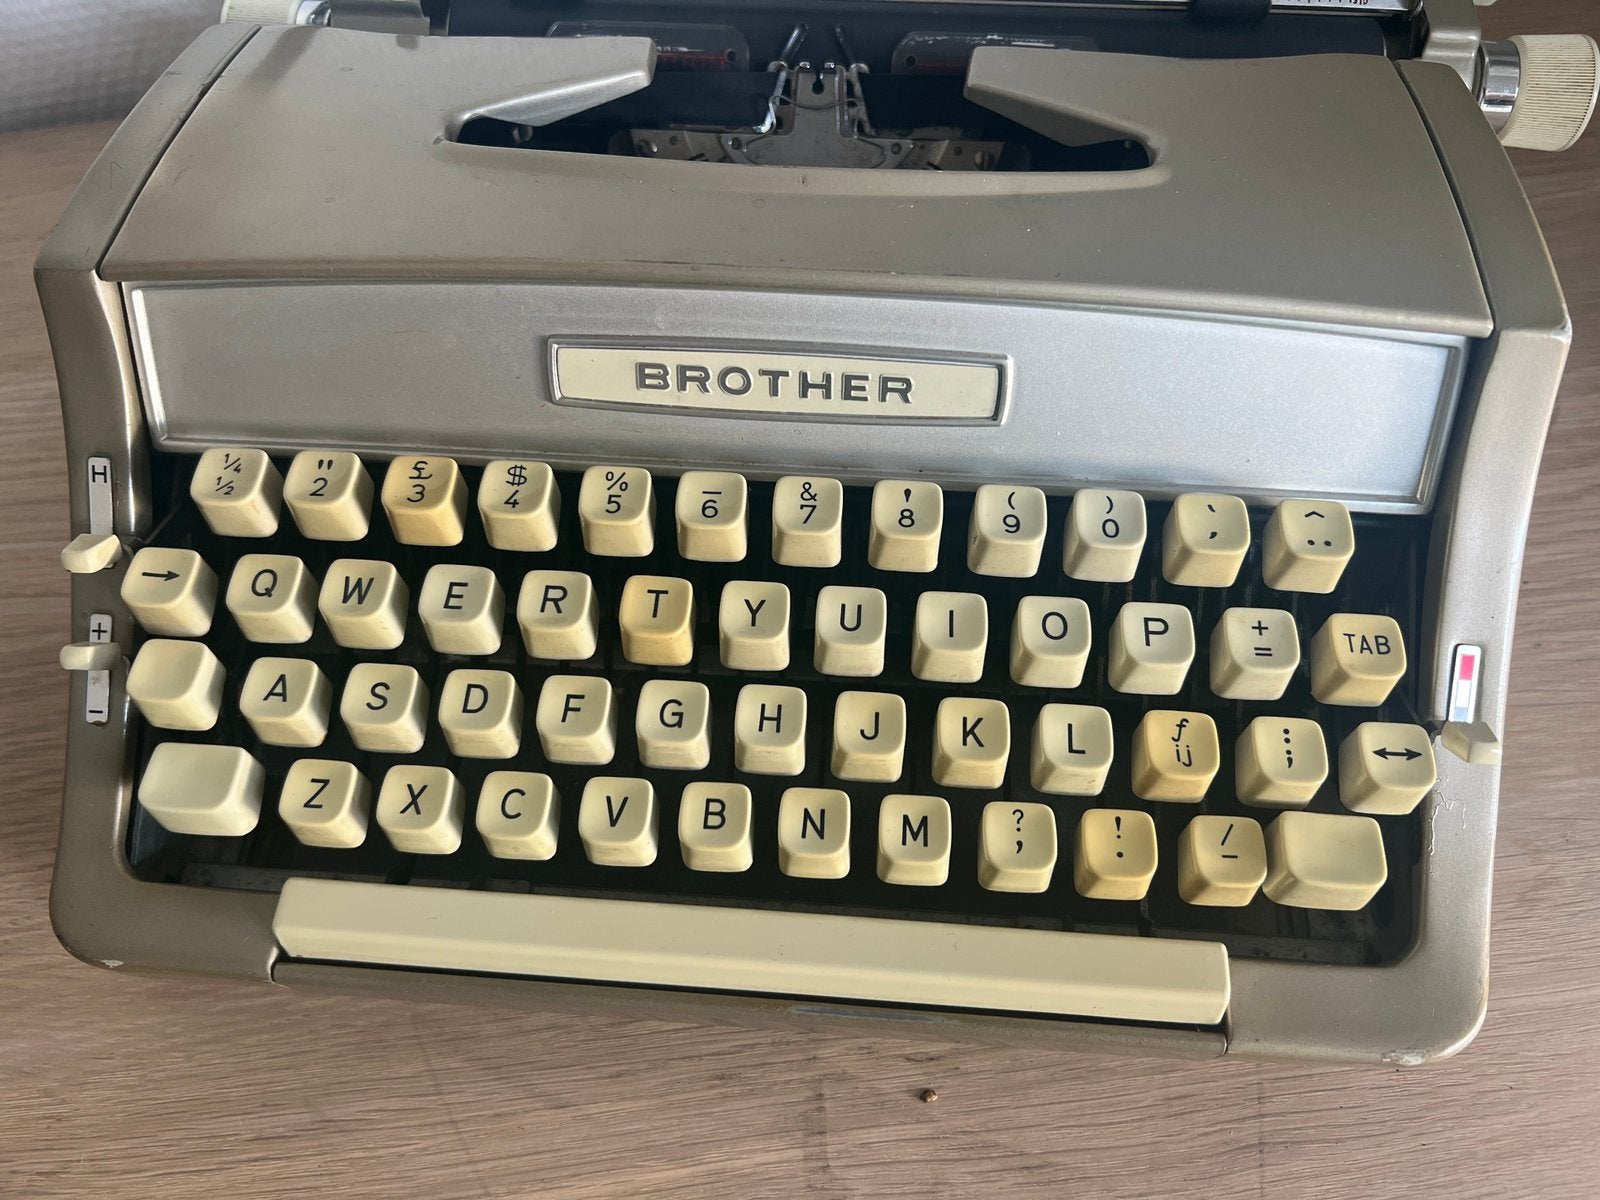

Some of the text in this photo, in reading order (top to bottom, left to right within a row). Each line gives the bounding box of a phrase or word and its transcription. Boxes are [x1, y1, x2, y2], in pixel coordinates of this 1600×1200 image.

[635, 362, 914, 404] BROTHER
[91, 465, 108, 483] H
[408, 460, 434, 480] £
[504, 465, 529, 489] $
[606, 470, 630, 492] %
[310, 478, 327, 496] 2
[407, 484, 425, 502] 3
[503, 490, 521, 509] 4
[800, 481, 820, 503] &
[1008, 492, 1015, 510] (
[604, 494, 624, 514] 5
[701, 498, 719, 519] 6
[799, 504, 818, 525] 7
[1105, 495, 1114, 515] )
[898, 509, 915, 528] 8
[1003, 514, 1020, 533] 9
[252, 569, 277, 597] Q
[341, 575, 375, 606] W
[444, 582, 468, 609] E
[540, 585, 568, 613] R
[647, 590, 669, 618] T
[744, 598, 767, 628] Y
[840, 604, 862, 631] U
[1042, 612, 1068, 640] O
[1144, 617, 1169, 646] P
[1343, 633, 1391, 655] TAB
[263, 674, 287, 702] A
[366, 682, 390, 710] S
[462, 684, 488, 713] D
[561, 694, 585, 722] F
[660, 699, 684, 728] G
[759, 704, 782, 733] H
[860, 712, 879, 740] J
[961, 716, 985, 747] K
[1067, 722, 1088, 755] L
[303, 778, 330, 808] Z
[400, 784, 428, 815] X
[501, 789, 526, 819] C
[606, 796, 628, 827] V
[703, 798, 726, 829] B
[802, 808, 825, 840] N
[1012, 809, 1025, 832] ?
[902, 815, 928, 847] M
[1114, 816, 1122, 839] !
[1220, 823, 1234, 847] /
